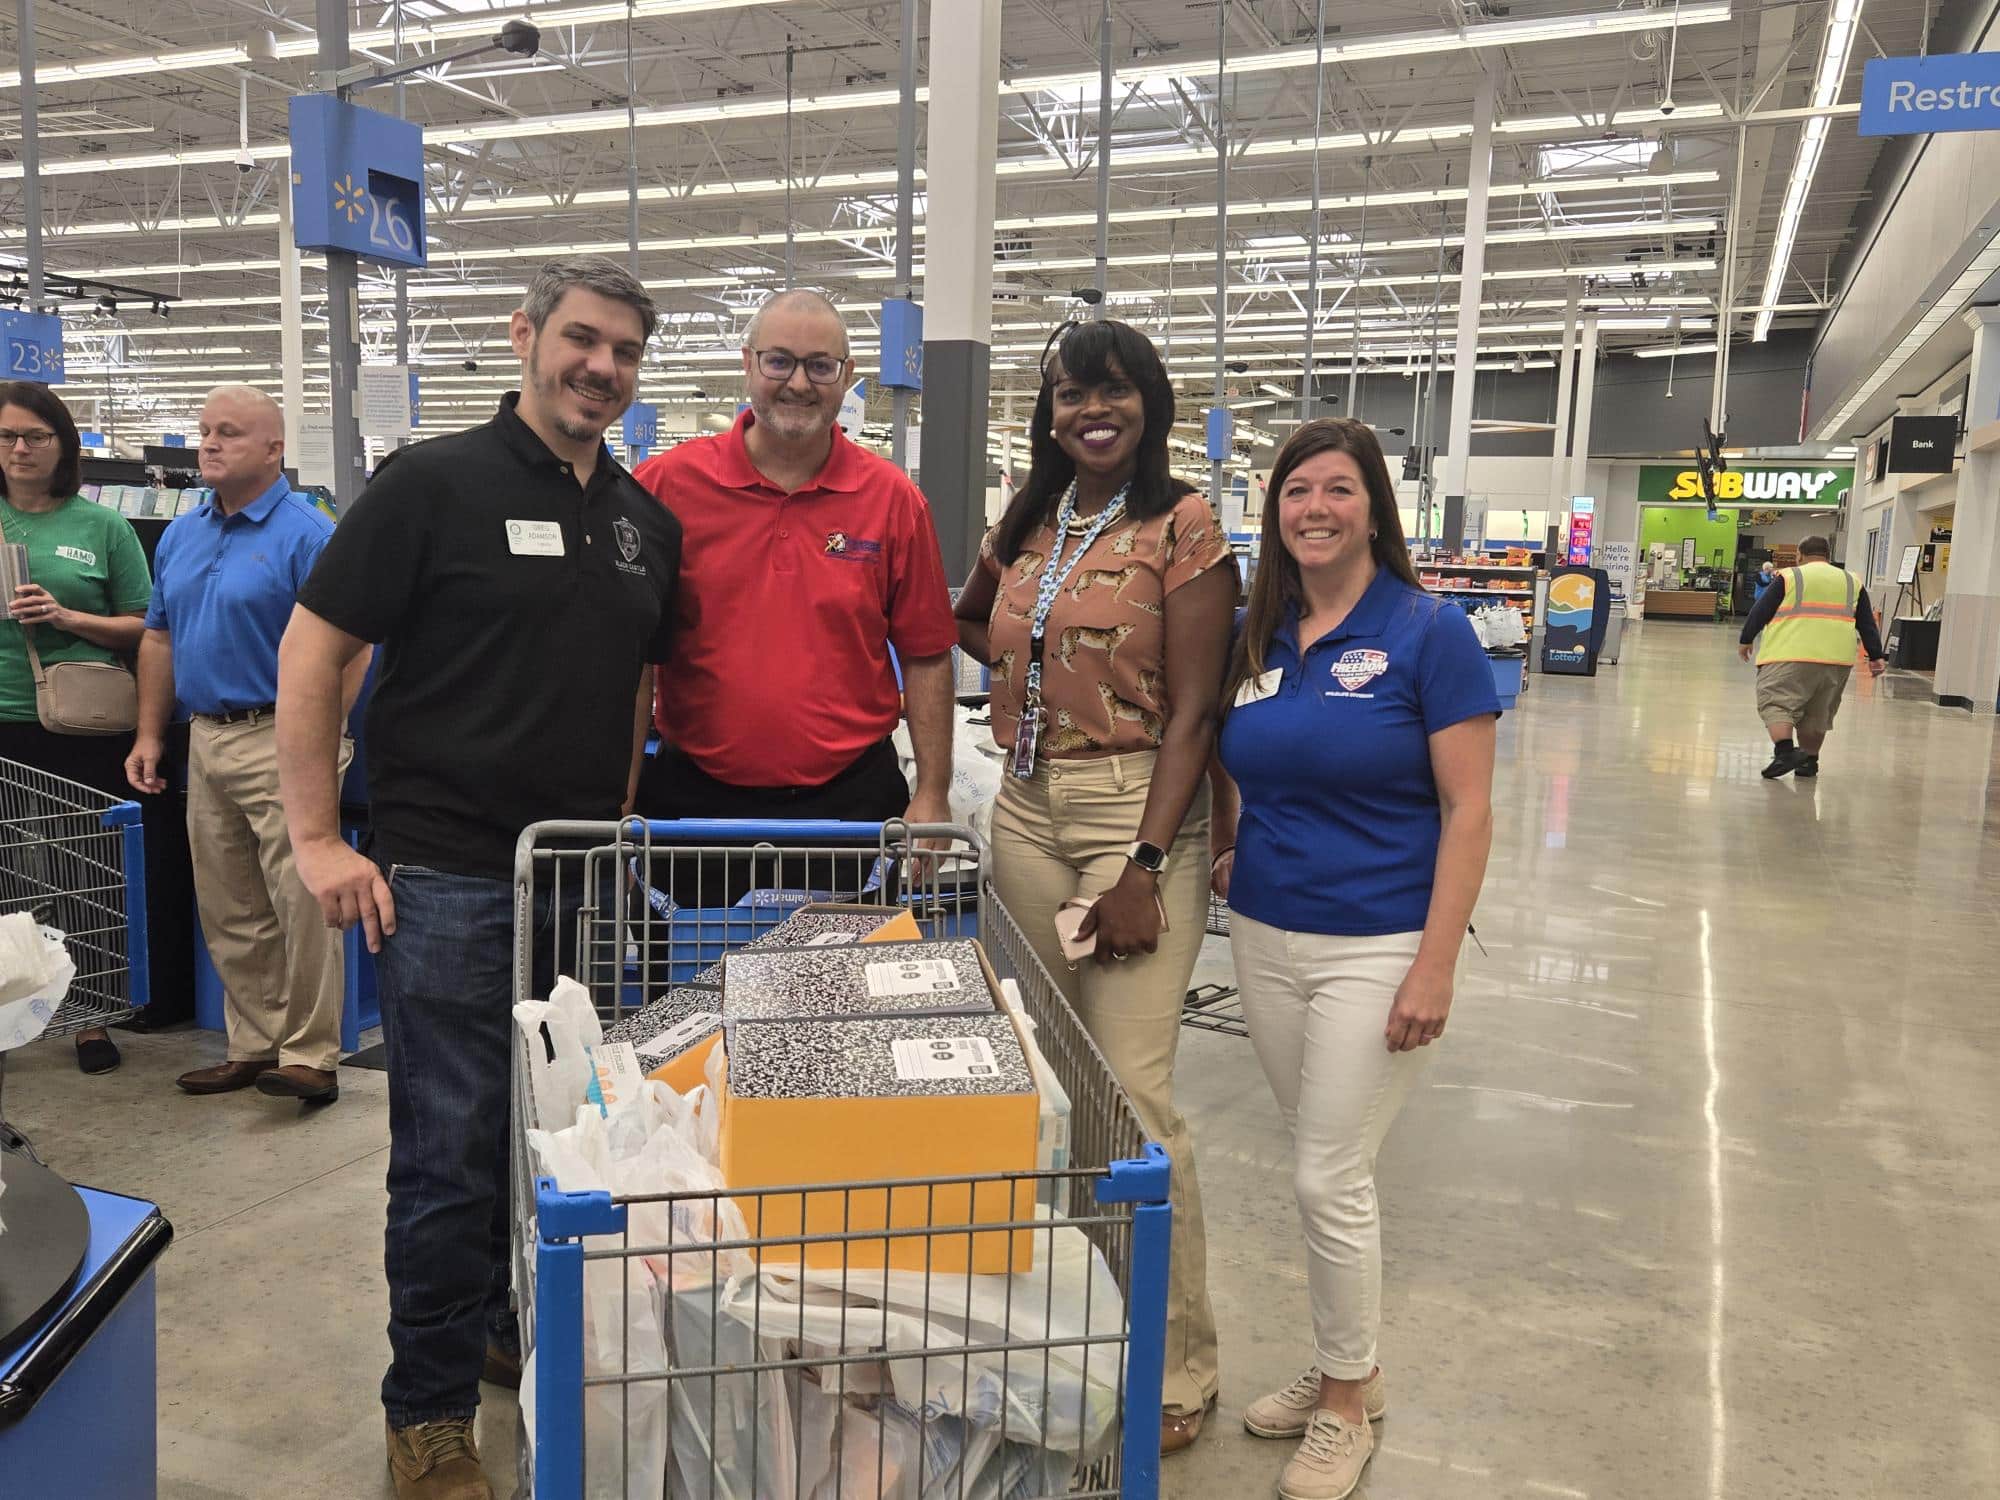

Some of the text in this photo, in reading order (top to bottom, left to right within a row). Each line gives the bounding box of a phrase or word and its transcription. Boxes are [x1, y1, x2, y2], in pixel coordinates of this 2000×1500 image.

[368, 192, 413, 251] 26
[11, 342, 41, 374] 23
[643, 423, 655, 442] 19
[1912, 440, 1934, 449] Bank
[1668, 470, 1838, 500] SUBWAY
[1605, 545, 1631, 553] Hello.
[1549, 652, 1584, 664] Lottery
[770, 893, 814, 905] Walmart
